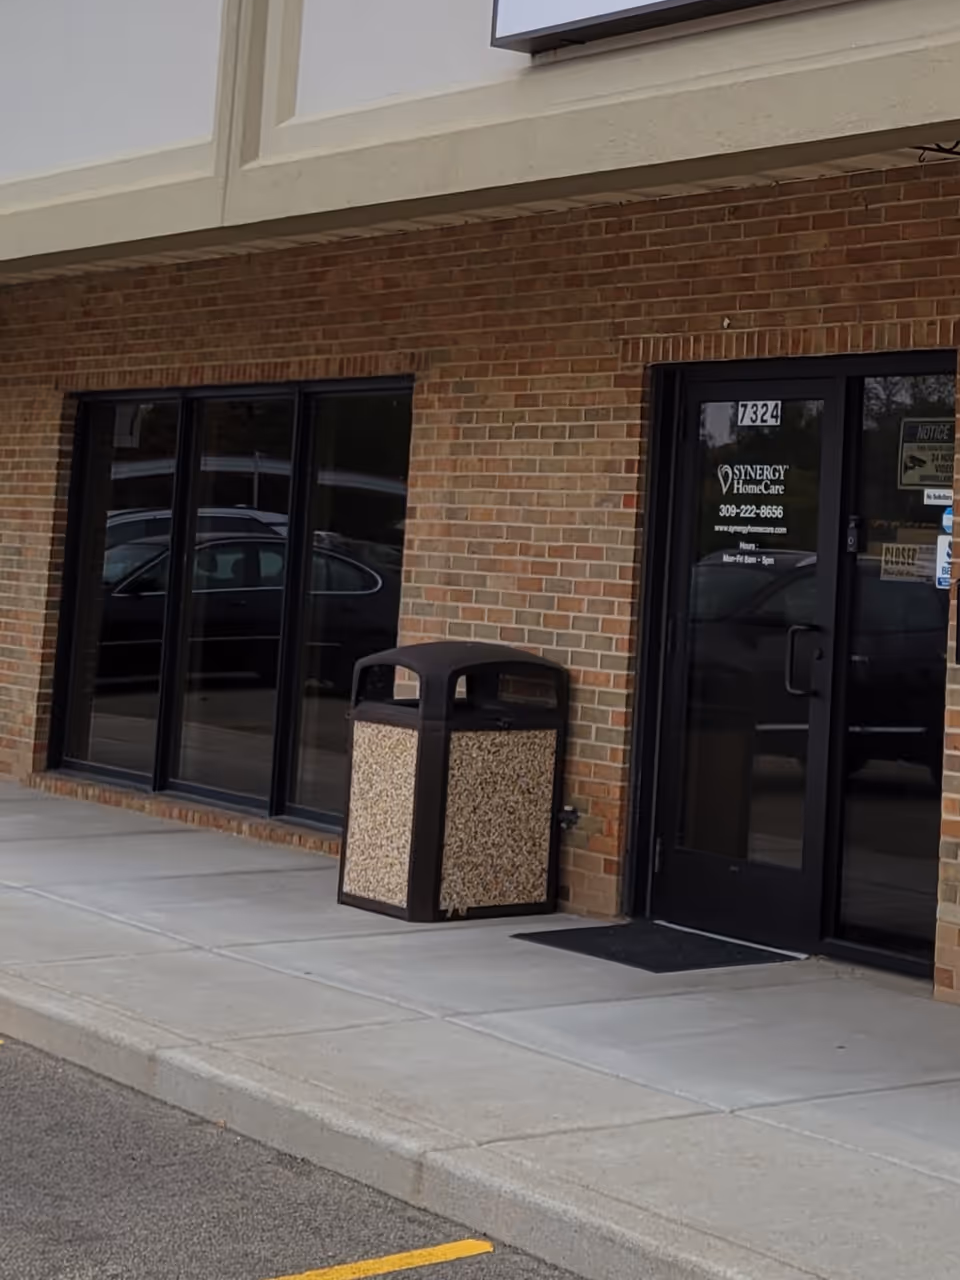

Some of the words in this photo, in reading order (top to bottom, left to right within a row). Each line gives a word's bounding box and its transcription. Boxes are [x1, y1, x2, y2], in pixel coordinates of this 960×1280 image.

[739, 401, 781, 425] 7324
[917, 424, 949, 440] NOTICE
[733, 480, 785, 494] HomeCare
[719, 504, 784, 518] 309-222-8656
